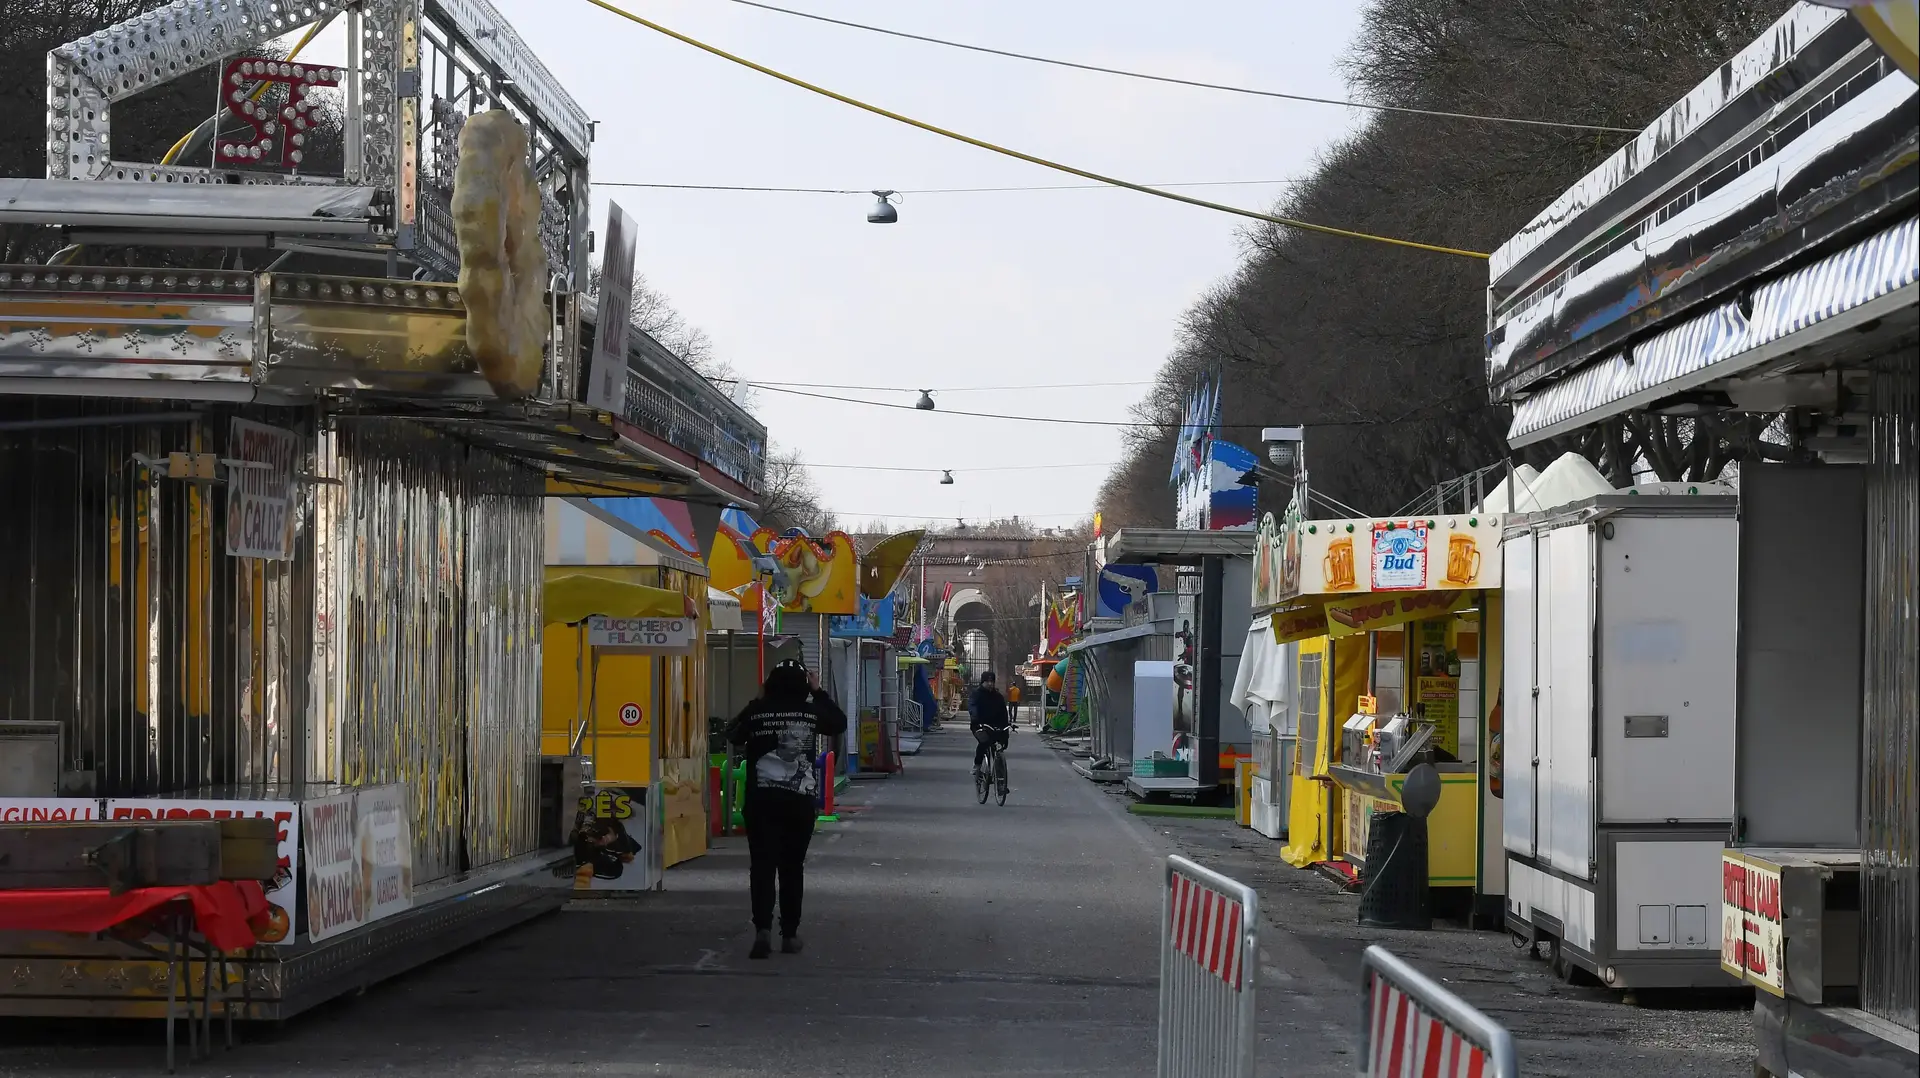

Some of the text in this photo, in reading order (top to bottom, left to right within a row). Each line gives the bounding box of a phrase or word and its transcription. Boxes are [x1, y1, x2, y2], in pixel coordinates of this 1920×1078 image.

[244, 500, 283, 552] CALDE
[1383, 554, 1416, 570] Bud
[1351, 600, 1396, 623] HOT
[593, 619, 684, 632] ZUCCHERO
[608, 632, 668, 644] FILATO
[625, 709, 637, 719] 80
[750, 712, 775, 721] LESSON
[312, 801, 353, 869] FRITTELLE
[319, 870, 354, 930] CALDE
[1723, 860, 1781, 926] FRITTELLE CALDE
[1734, 937, 1768, 977] NUTELLA
